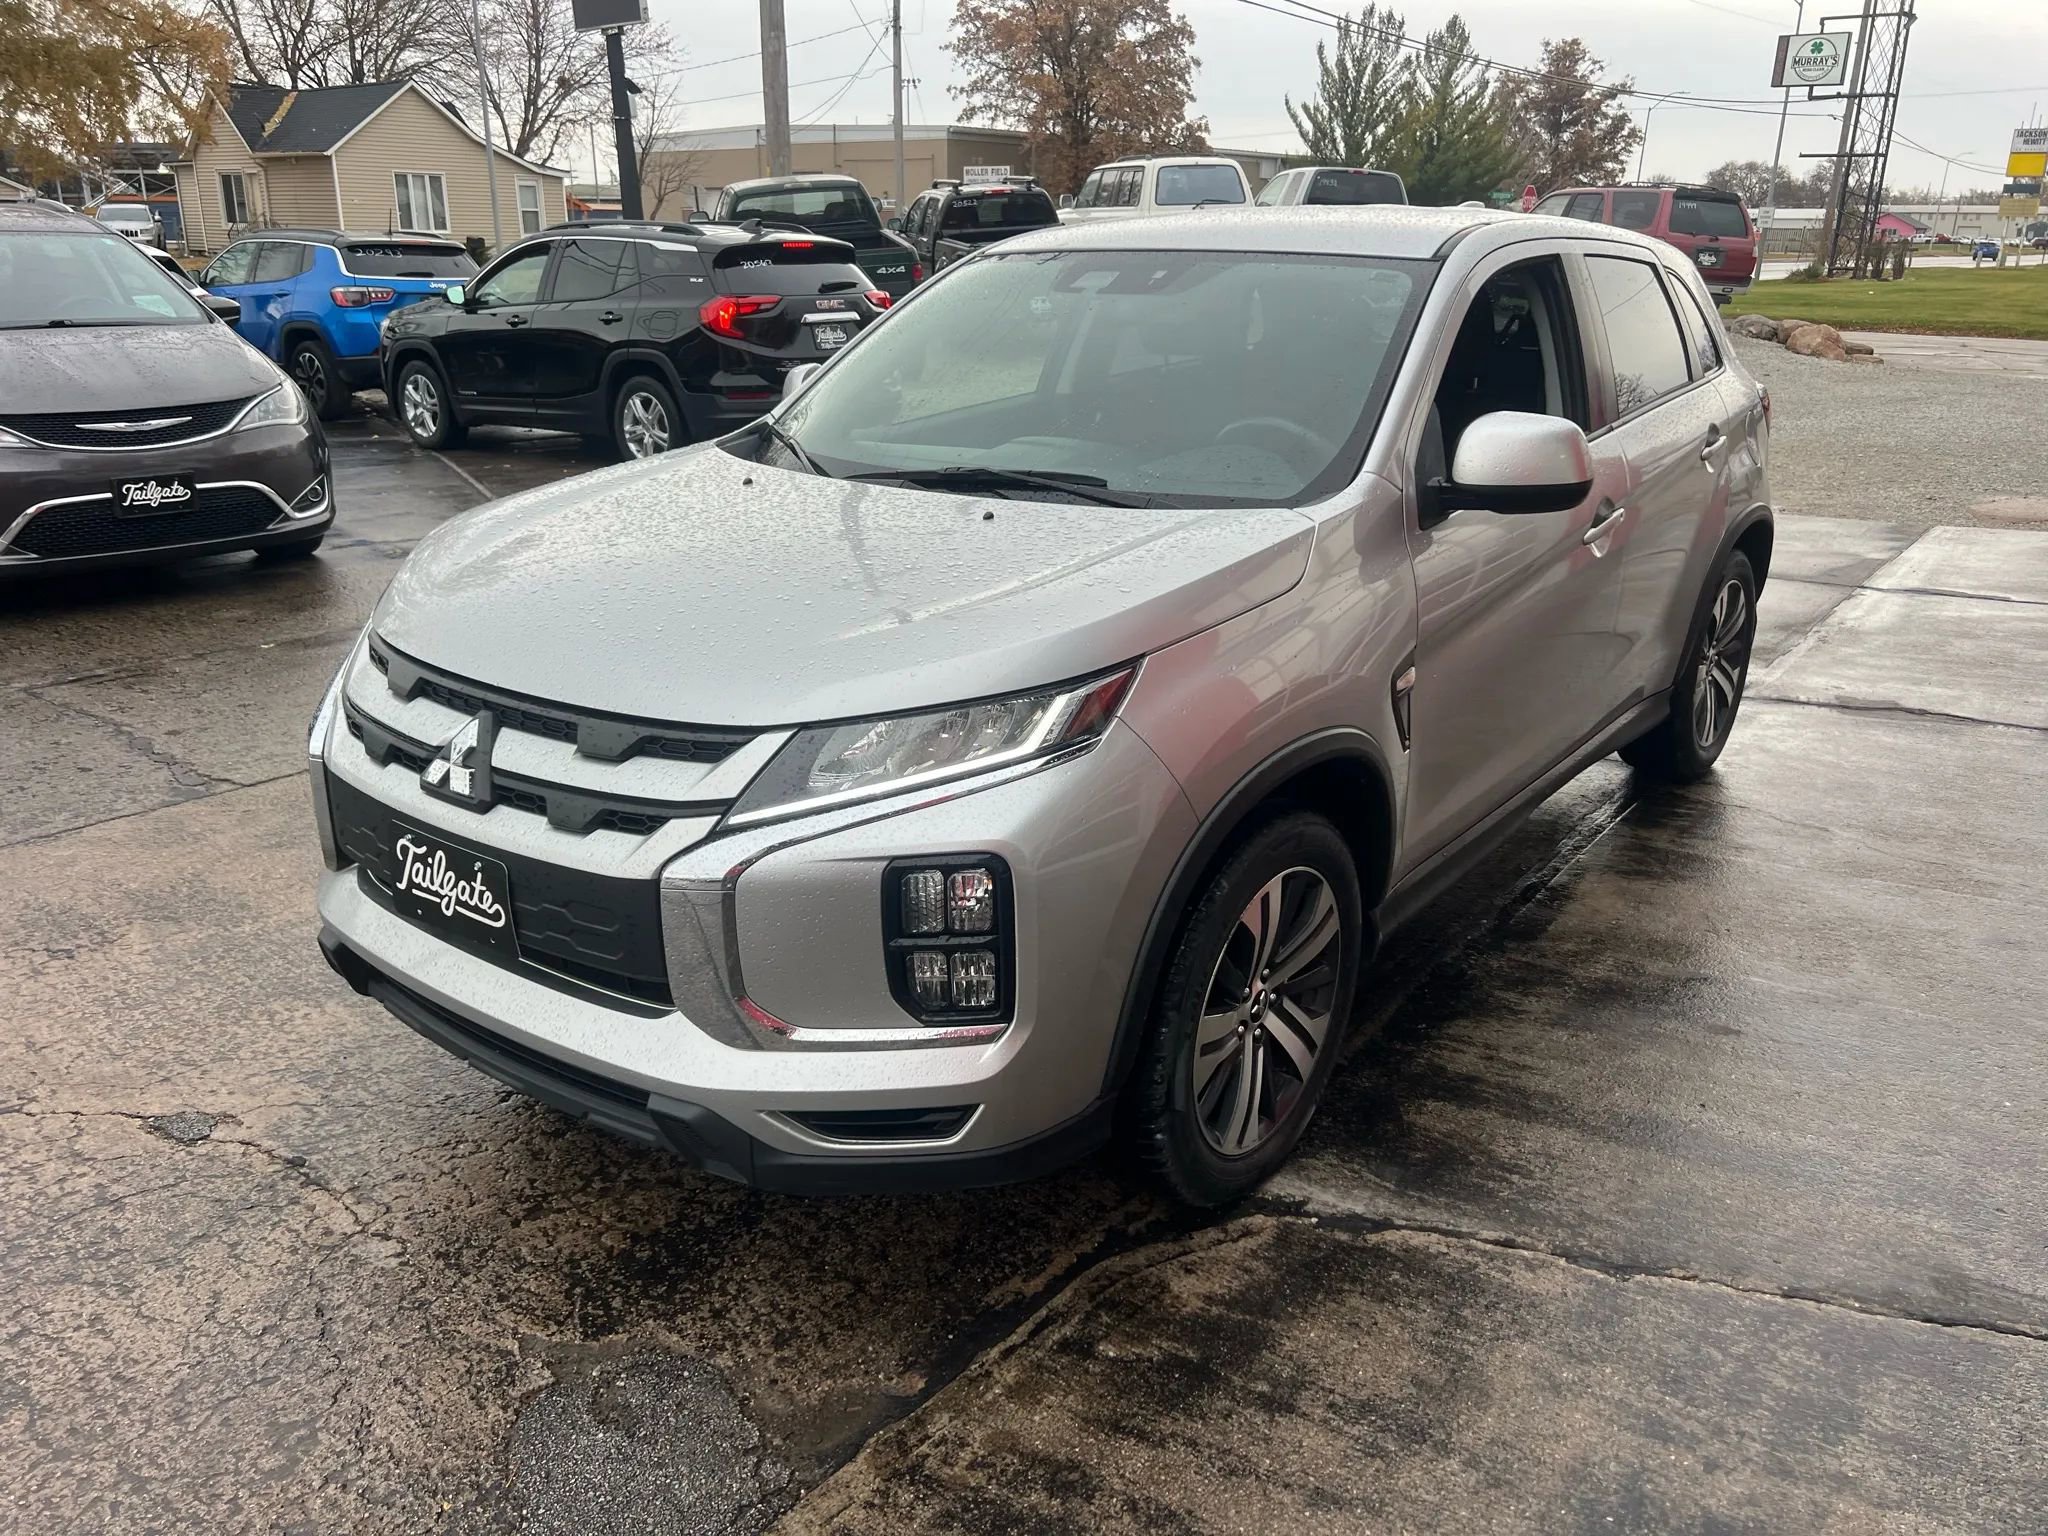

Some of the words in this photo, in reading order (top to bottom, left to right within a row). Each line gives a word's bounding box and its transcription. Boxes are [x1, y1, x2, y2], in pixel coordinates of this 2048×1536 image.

[1792, 56, 1838, 67] MURRAY'S
[2016, 130, 2047, 138] JACKSON
[990, 167, 1009, 177] FIELD
[816, 299, 846, 309] GMC
[121, 480, 192, 507] Tailgate
[396, 838, 506, 928] Tailgate
